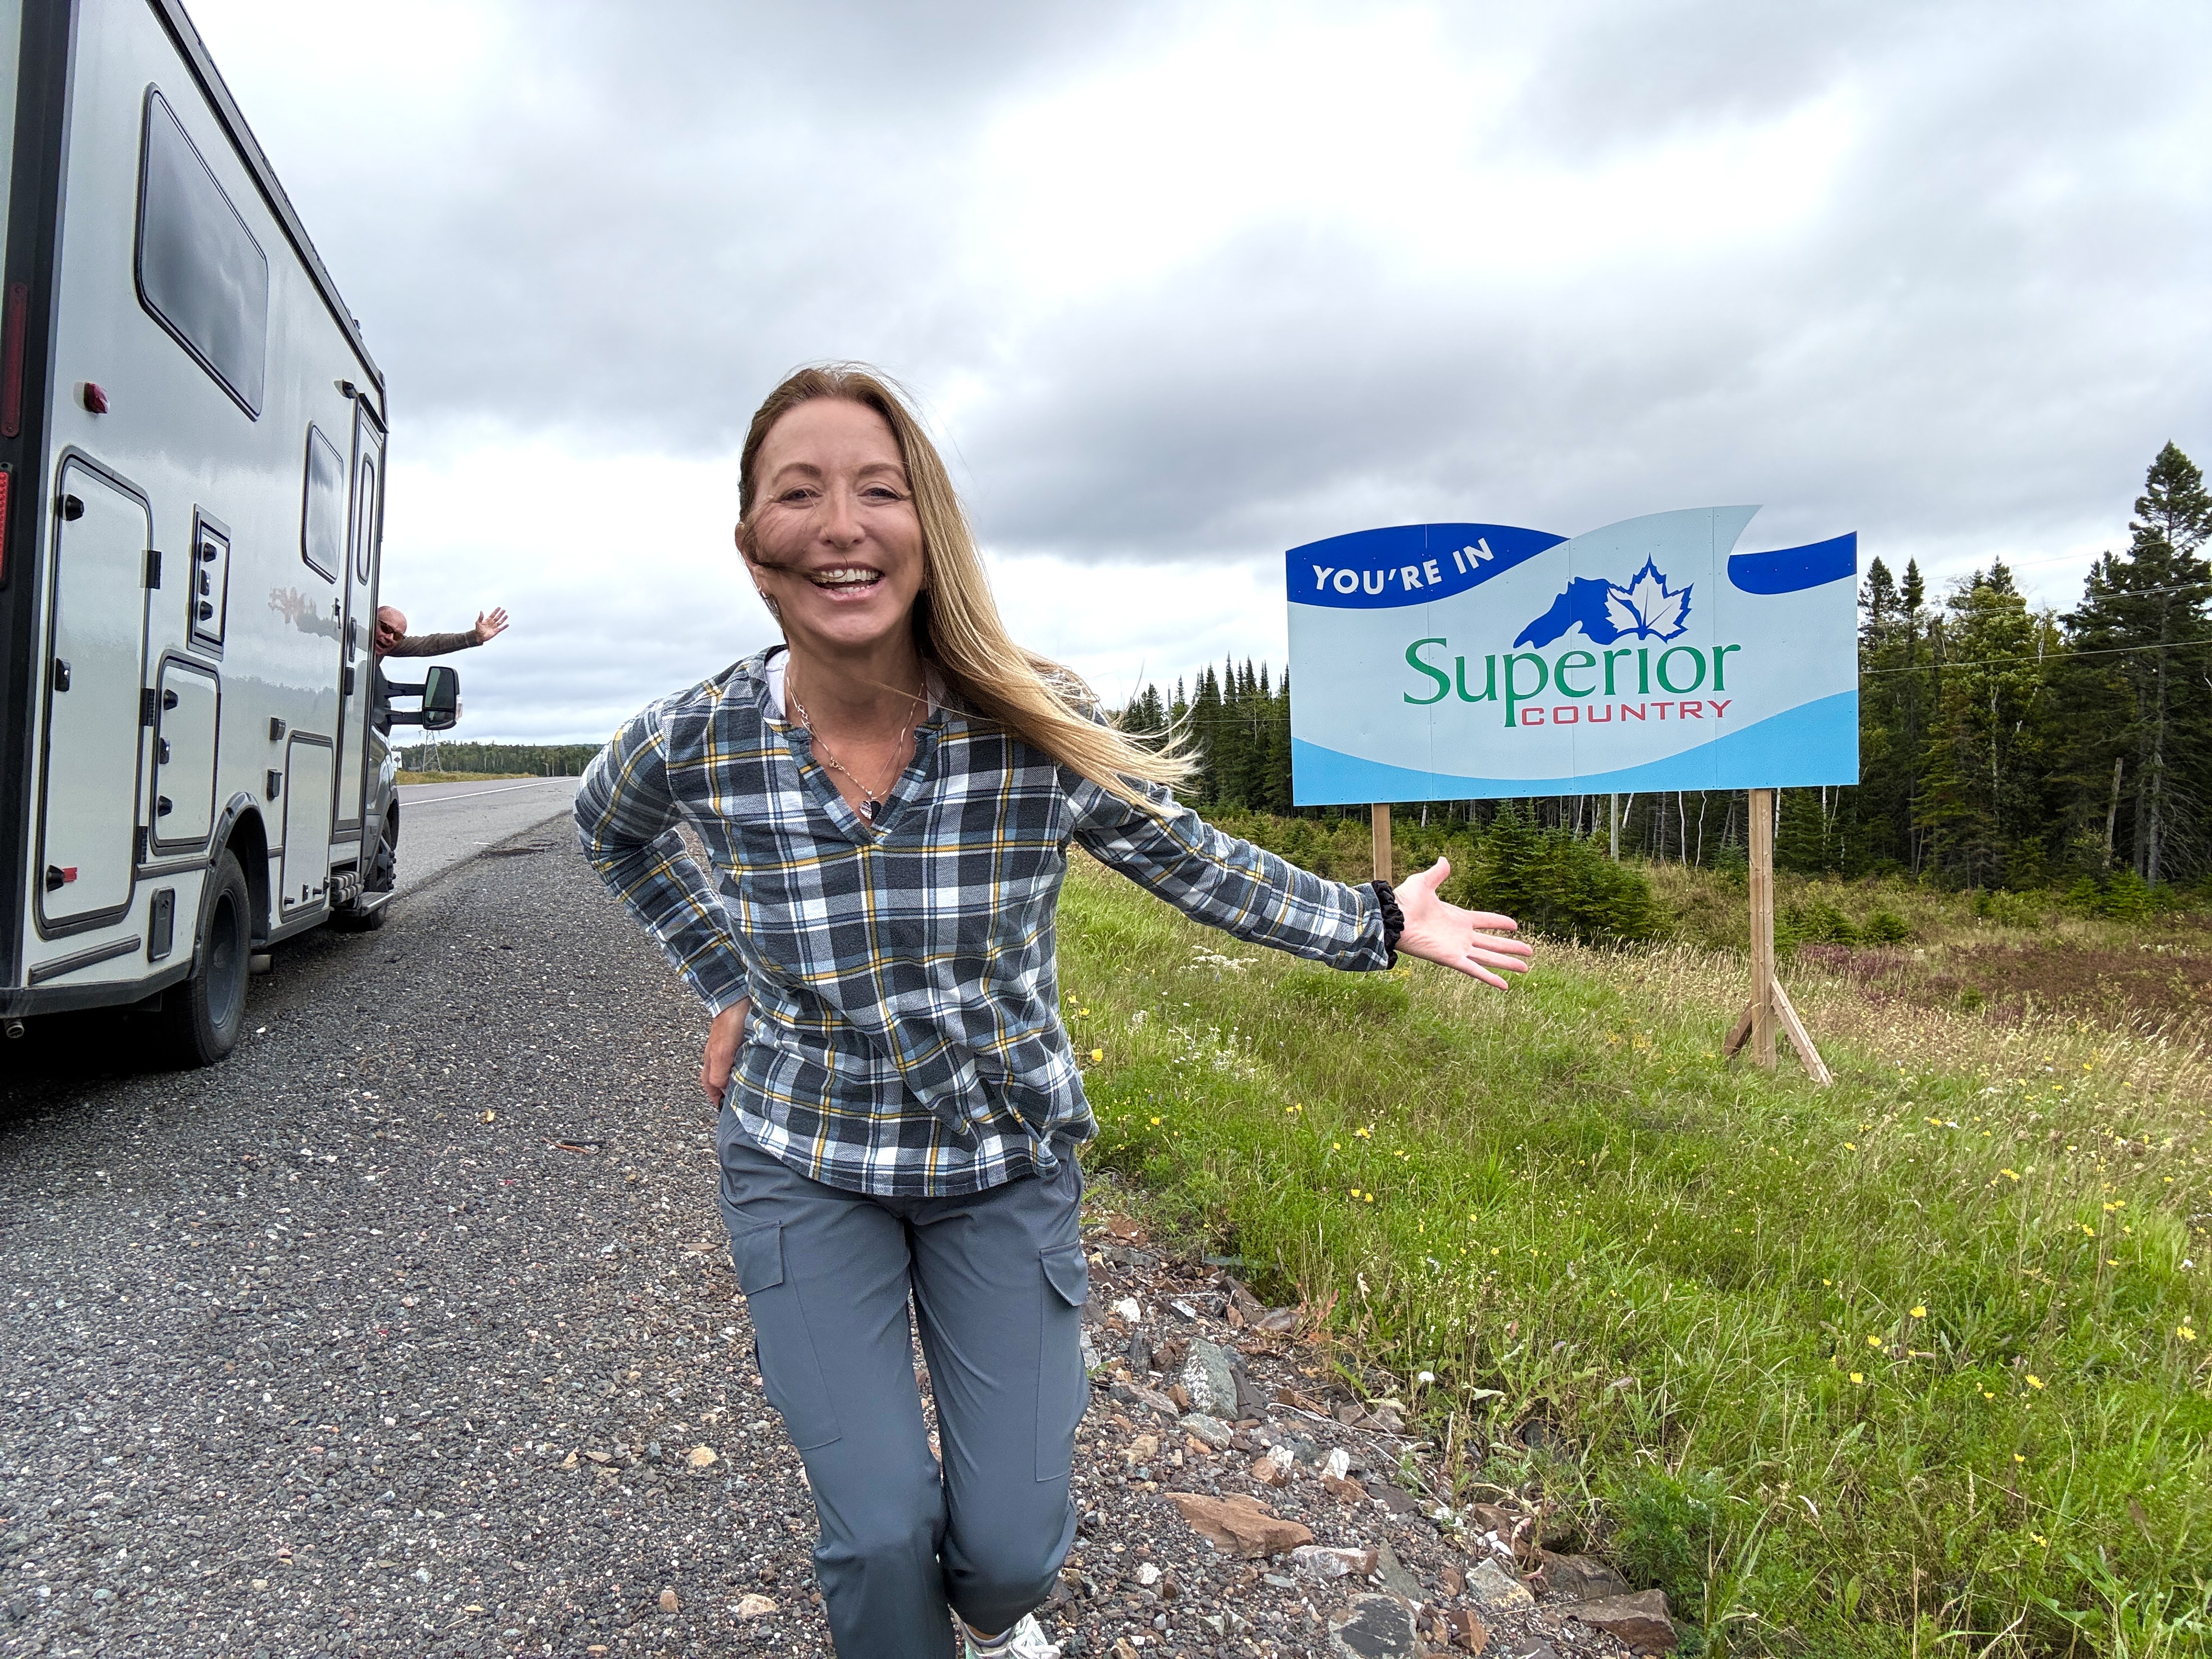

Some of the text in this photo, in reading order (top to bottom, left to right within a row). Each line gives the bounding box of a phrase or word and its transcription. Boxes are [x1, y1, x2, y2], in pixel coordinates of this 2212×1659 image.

[1312, 537, 1494, 595] YOU'RE IN
[1403, 637, 1741, 728] Superior
[1521, 699, 1733, 726] COUNTRY
